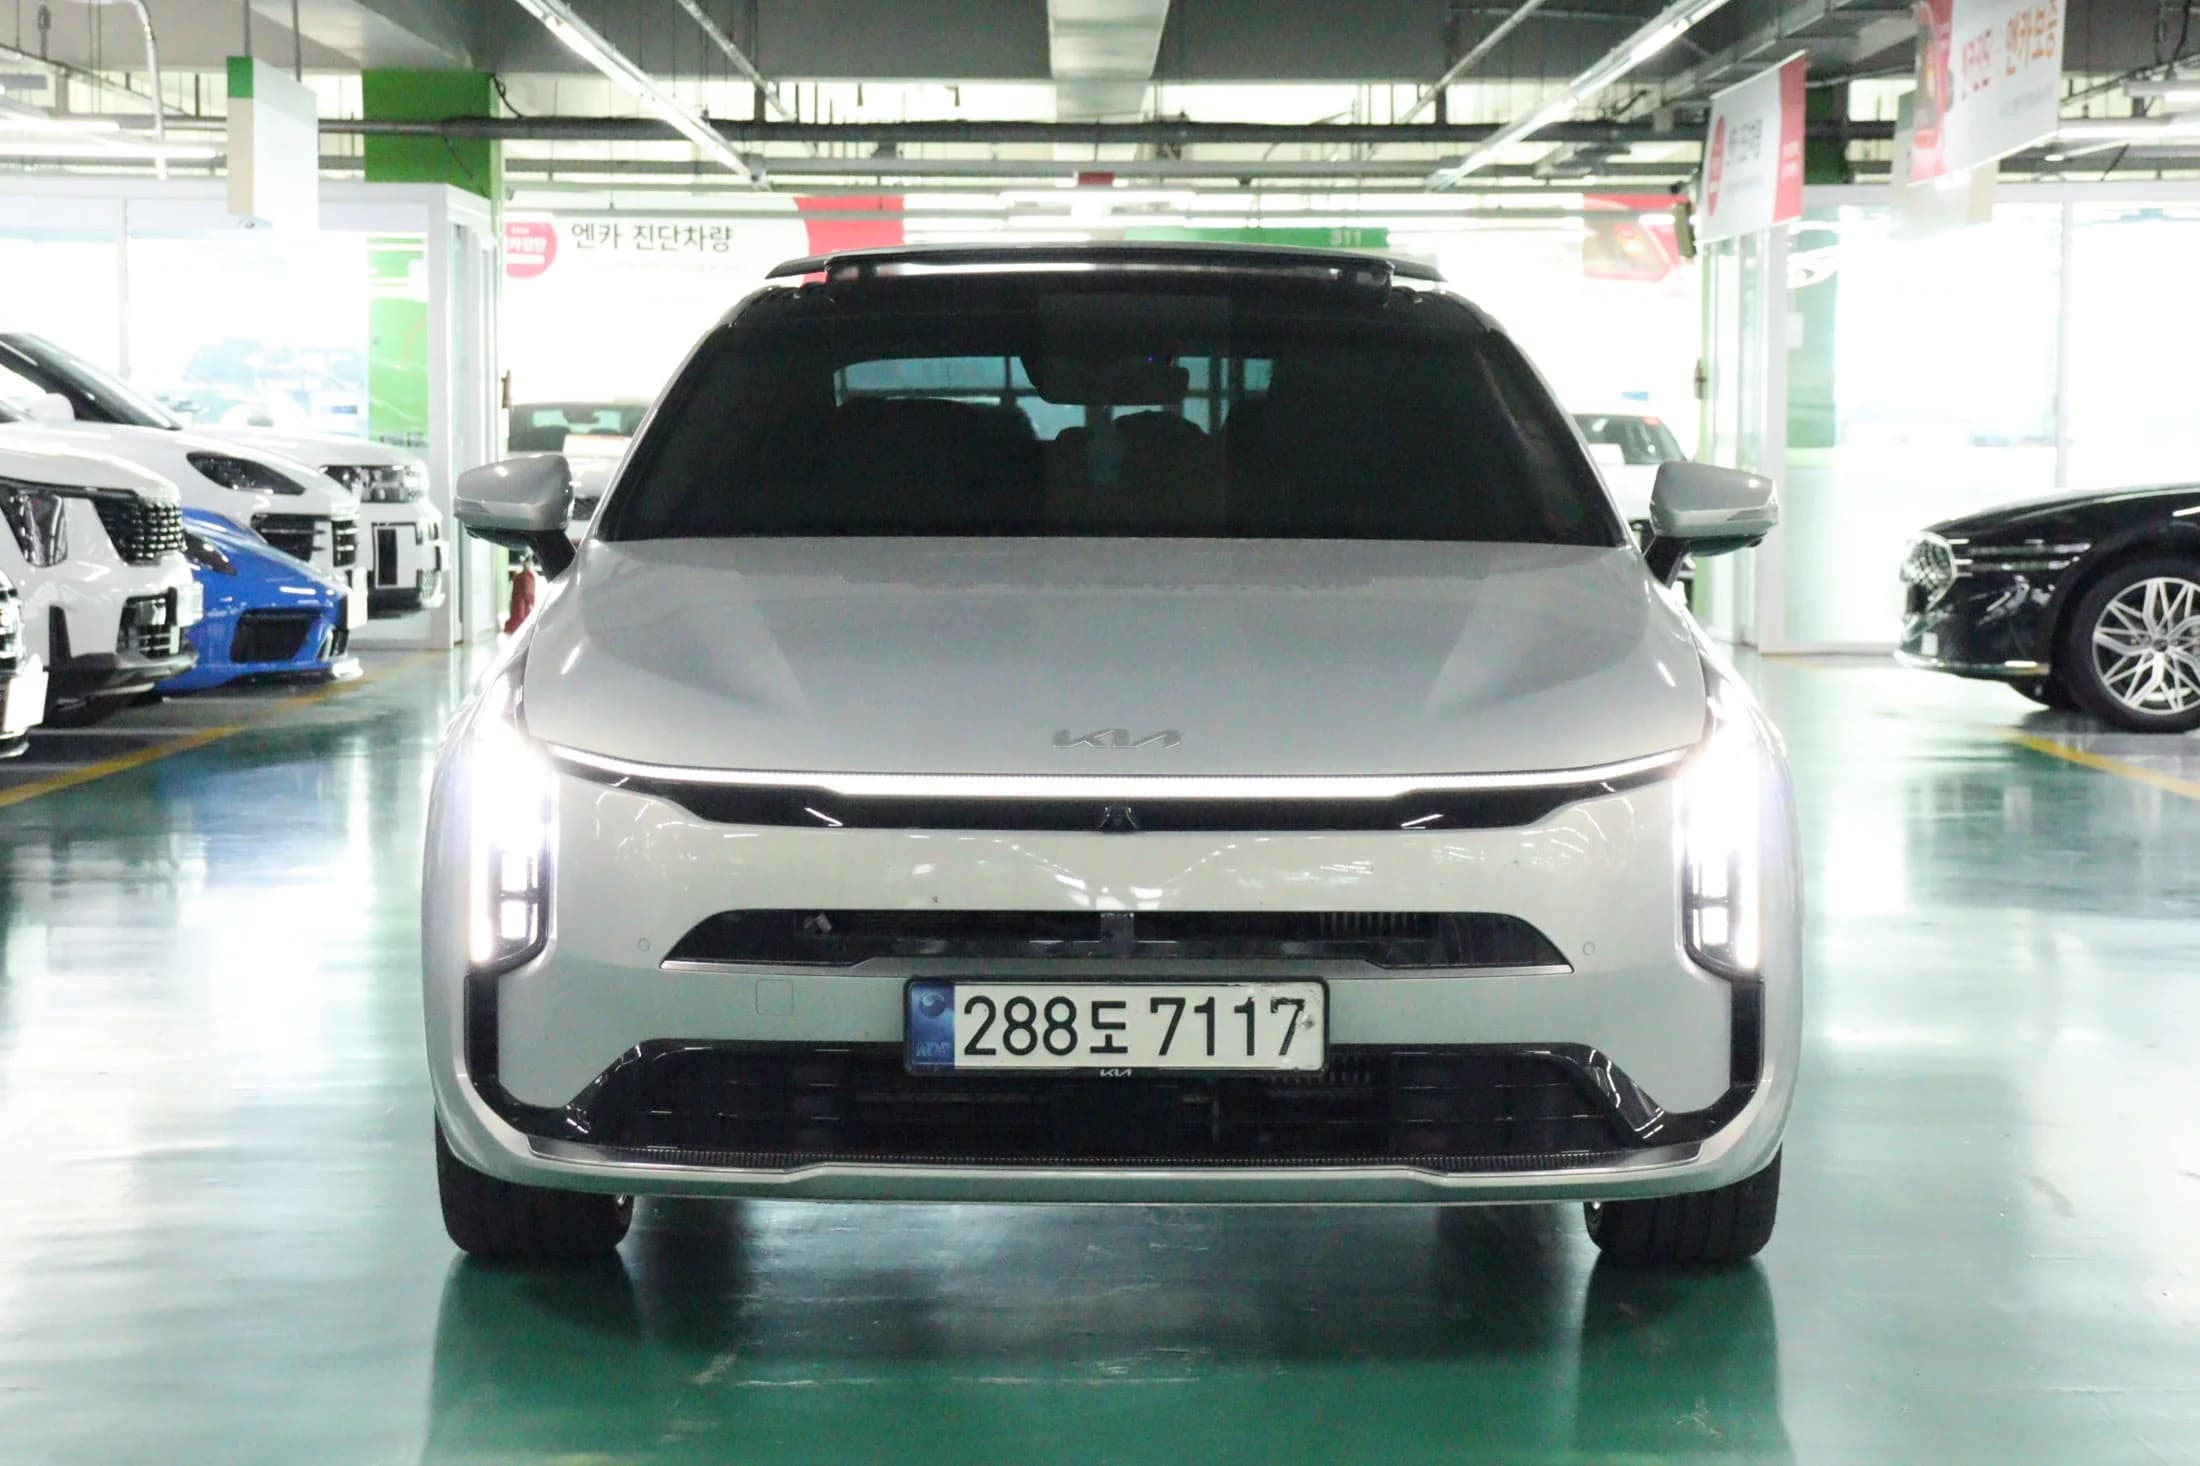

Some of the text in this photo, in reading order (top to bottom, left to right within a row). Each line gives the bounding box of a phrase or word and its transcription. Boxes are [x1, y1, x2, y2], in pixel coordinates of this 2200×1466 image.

[571, 223, 732, 252] 엔카 진단차량
[1053, 728, 1182, 749] KIA
[964, 996, 1305, 1056] 288도 7117
[1100, 1068, 1132, 1078] KIA
